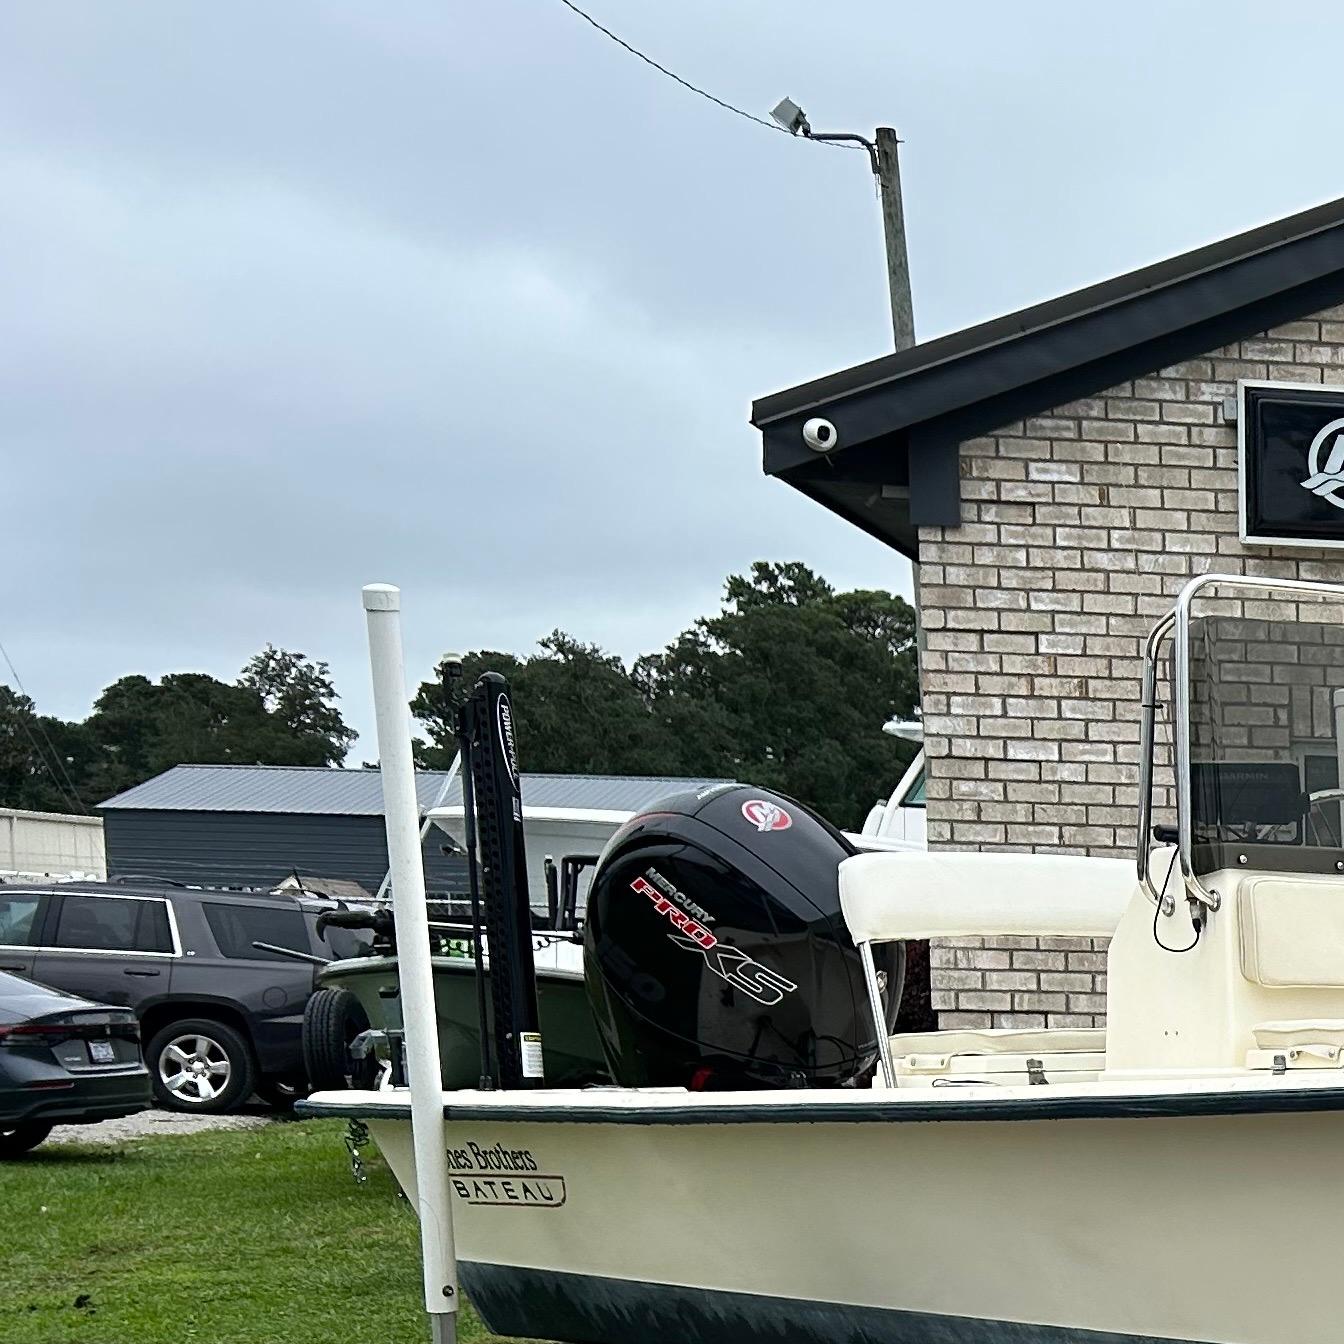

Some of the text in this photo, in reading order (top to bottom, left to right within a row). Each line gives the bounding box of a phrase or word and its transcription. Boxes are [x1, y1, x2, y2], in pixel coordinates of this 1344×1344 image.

[629, 876, 718, 950] PRO
[645, 866, 717, 923] MERCURY
[666, 933, 798, 1006] XS
[446, 1141, 538, 1171] nes Brothers
[452, 1179, 554, 1201] BATEAU
